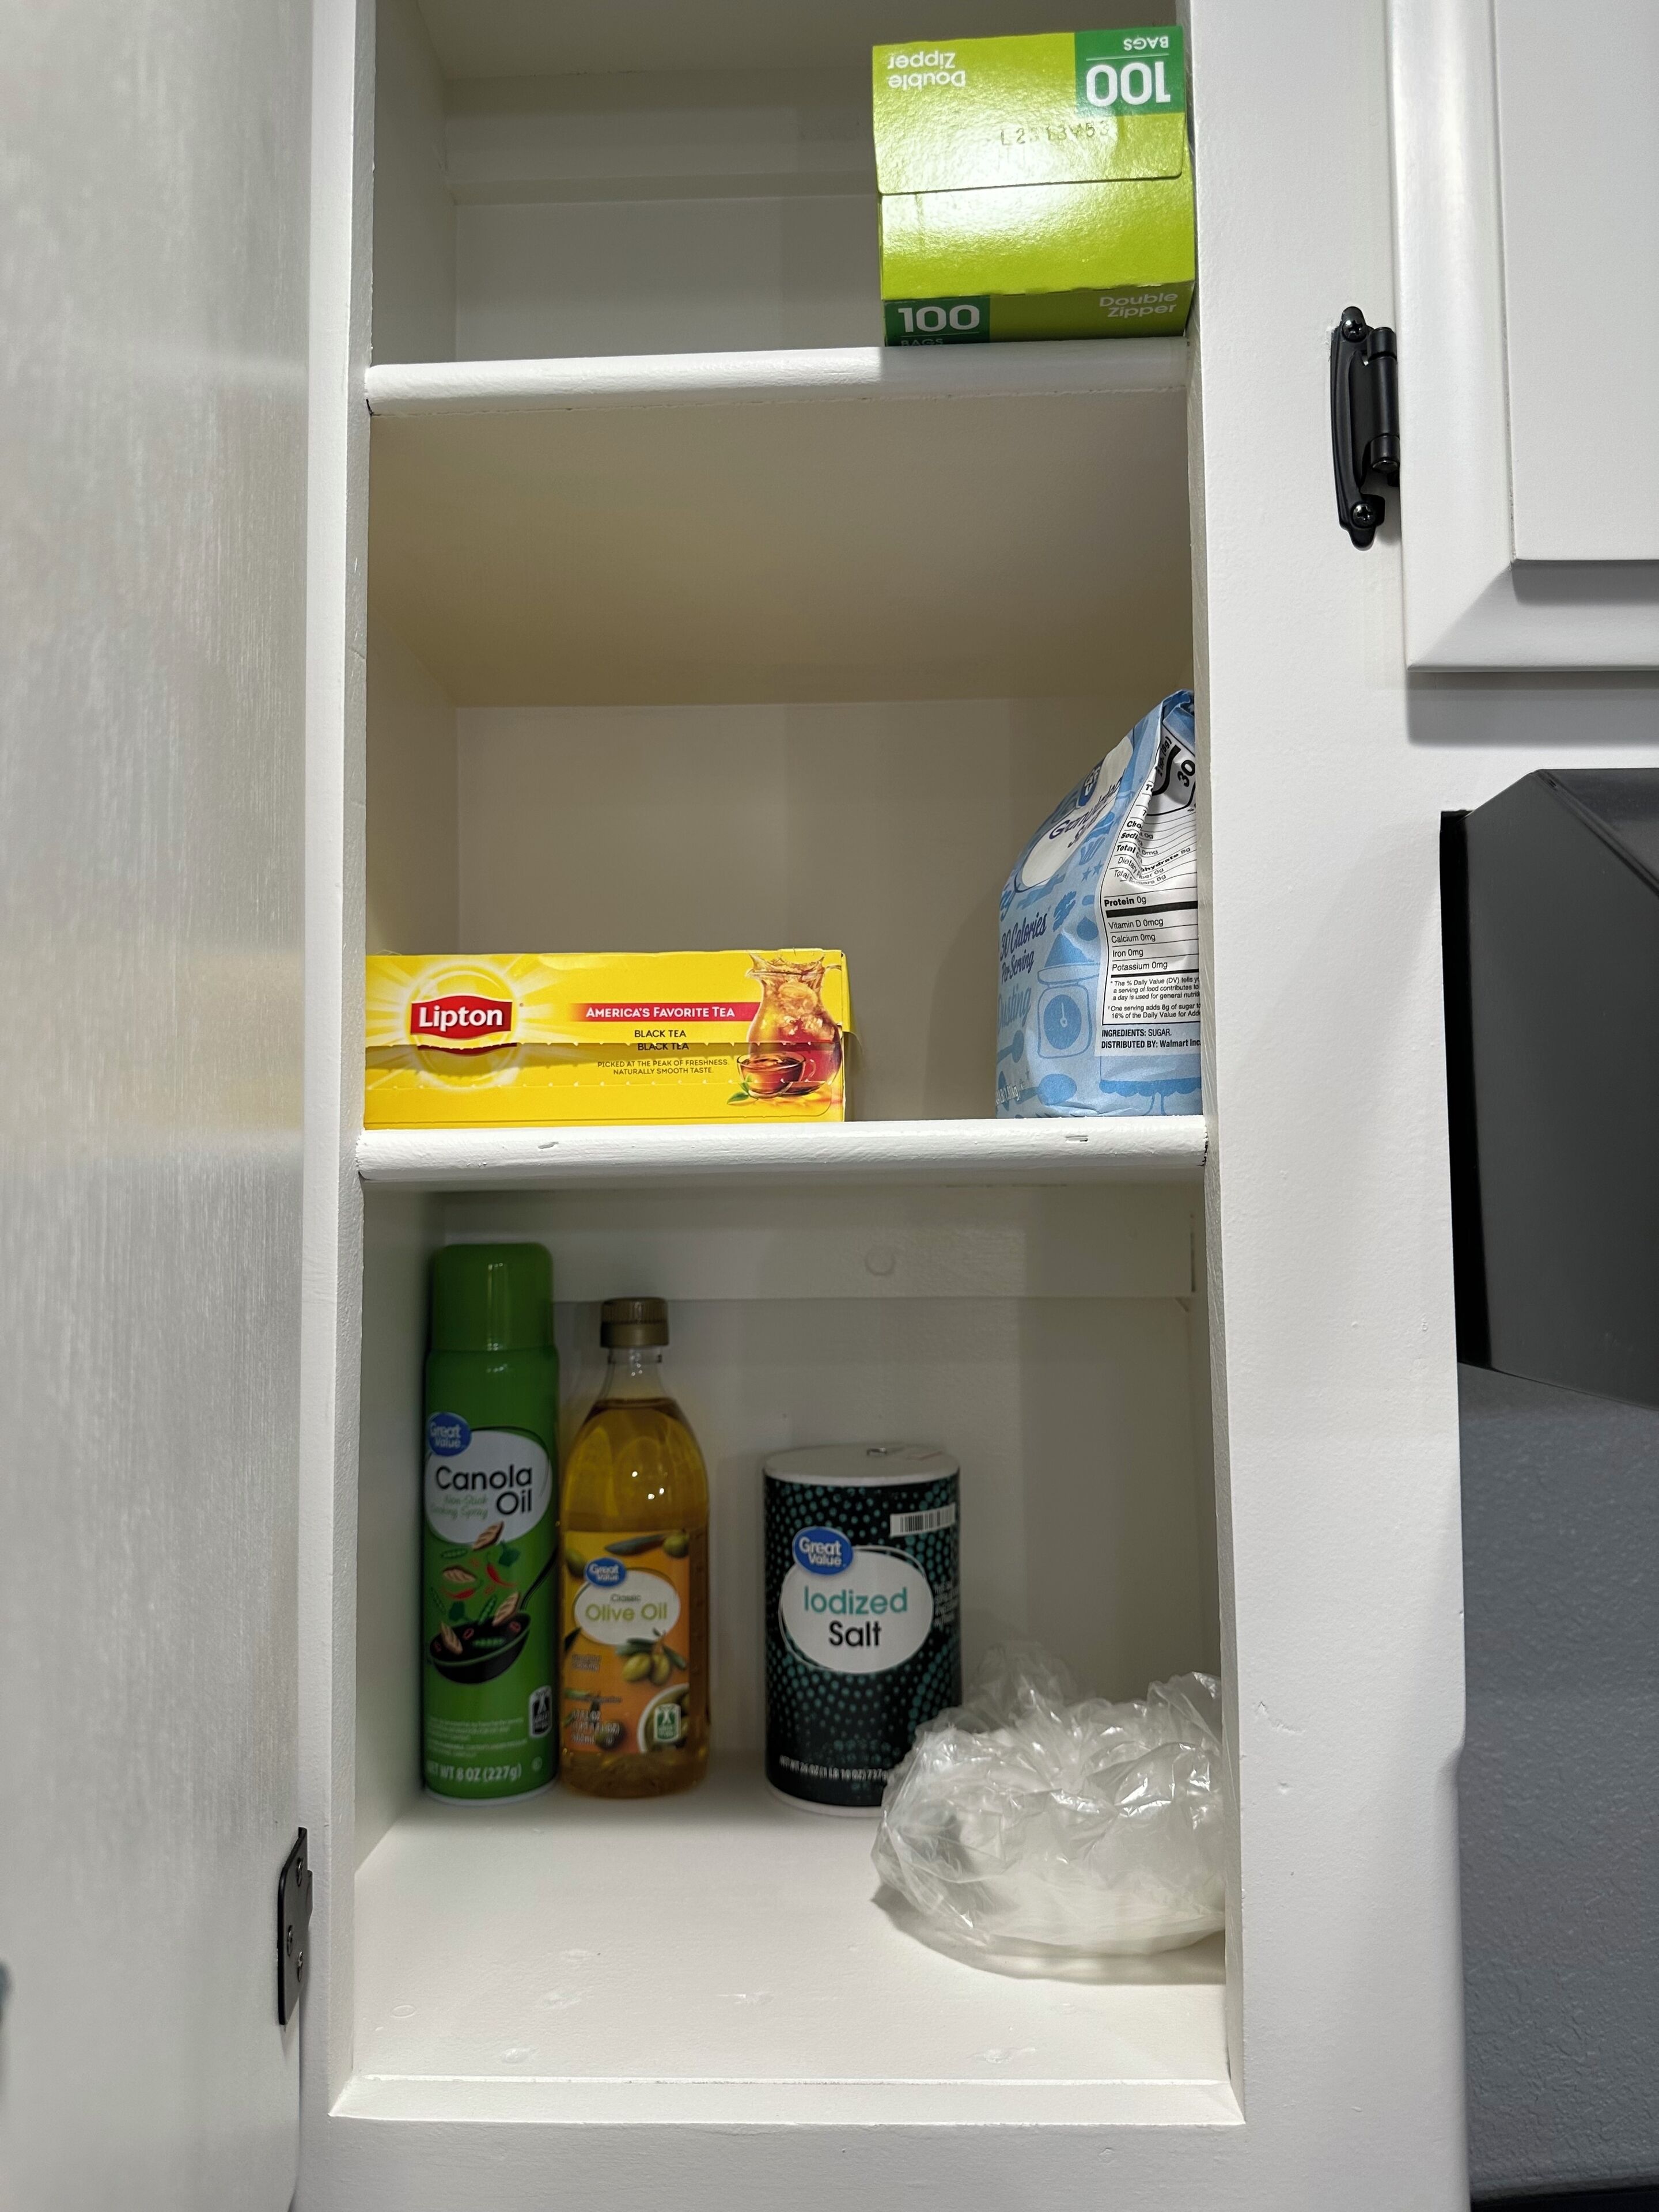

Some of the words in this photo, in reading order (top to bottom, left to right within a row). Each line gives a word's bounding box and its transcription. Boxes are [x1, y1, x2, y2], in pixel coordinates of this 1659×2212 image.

[1123, 35, 1169, 51] BAGS
[888, 51, 956, 70] Zipper
[888, 70, 966, 92] Double
[1085, 60, 1172, 108] 100
[1099, 292, 1178, 309] Double
[898, 305, 980, 334] 100
[1108, 304, 1177, 320] Zipper
[1177, 759, 1196, 788] 30
[1116, 844, 1137, 854] Total
[1118, 857, 1138, 873] Dietary
[1114, 870, 1130, 880] Total
[1104, 897, 1135, 907] Protein
[1137, 896, 1147, 904] 0g
[1108, 919, 1134, 930] Vitamin
[1136, 919, 1142, 927] D
[1143, 918, 1164, 927] 0mcg
[999, 929, 1012, 962] 30
[1010, 912, 1048, 954] Calories
[1111, 934, 1139, 944] Calcium
[1141, 933, 1156, 942] 0mg
[1112, 949, 1126, 958] Iron
[1127, 948, 1144, 957] 0mg
[1009, 949, 1035, 980] Serving
[1112, 961, 1150, 972] Potassium
[1152, 961, 1168, 970] 0mg
[419, 1005, 503, 1032] Lipton
[586, 1007, 650, 1018] AMERICA'S
[653, 1006, 710, 1018] FAVORITE
[711, 1006, 736, 1017] TEA
[1143, 1011, 1158, 1019] Daily
[634, 1029, 665, 1038] BLACK
[668, 1029, 687, 1038] TEA
[1102, 1029, 1147, 1037] INGREDIENTS:
[1148, 1028, 1172, 1037] SUGAR.
[637, 1043, 668, 1051] BLACK
[1101, 1040, 1145, 1049] DISTRIBUTED
[1146, 1040, 1158, 1048] BY:
[1159, 1039, 1188, 1048] Walmart
[430, 1422, 461, 1439] Great
[434, 1437, 461, 1448] Value
[435, 1464, 532, 1491] Canola
[497, 1489, 532, 1516] Oil
[798, 1536, 842, 1556] Great
[808, 1553, 843, 1566] Value
[589, 1563, 619, 1575] Great
[804, 1586, 908, 1615] Iodized
[585, 1603, 635, 1622] Olive
[641, 1603, 668, 1620] Oil
[828, 1620, 882, 1647] Salt
[440, 1763, 455, 1781] WT
[465, 1766, 482, 1782] OZ
[483, 1763, 522, 1783] (227g)
